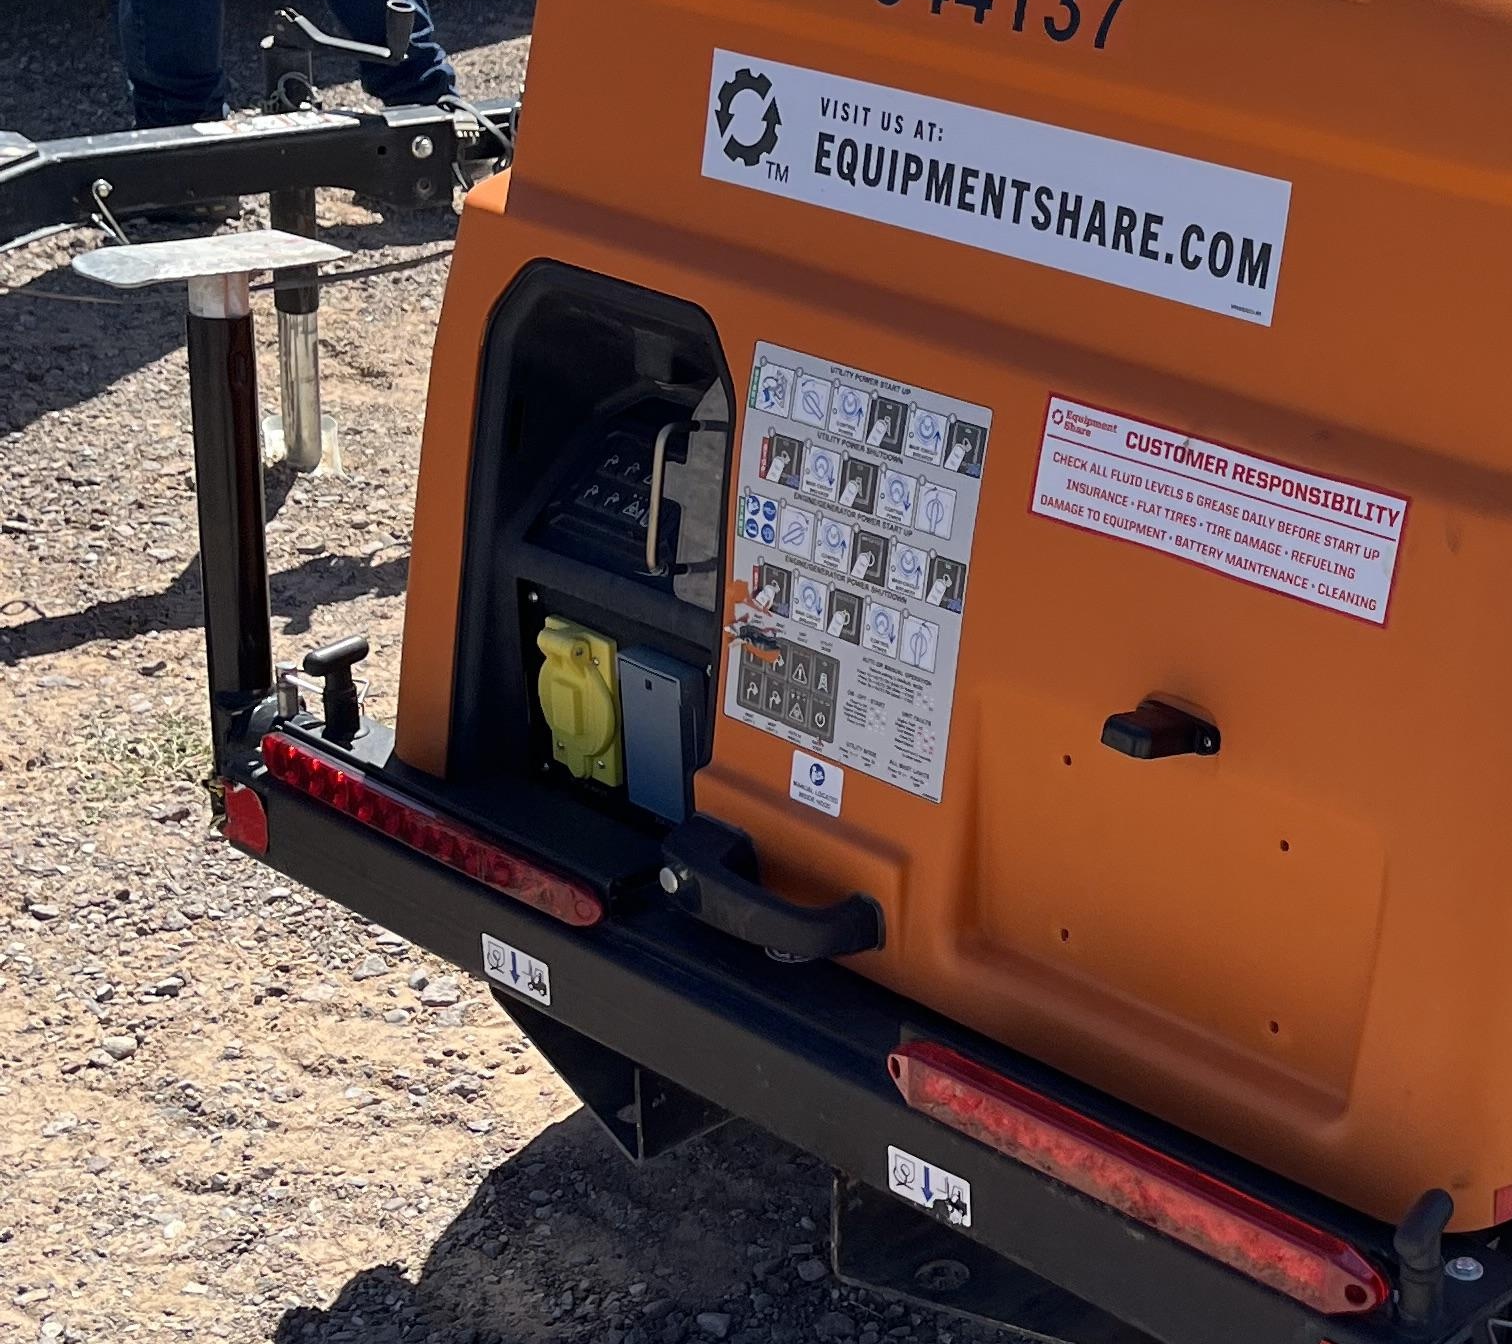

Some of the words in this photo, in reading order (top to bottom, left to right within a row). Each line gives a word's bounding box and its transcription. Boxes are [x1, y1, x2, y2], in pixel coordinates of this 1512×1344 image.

[818, 95, 871, 128] VISIT
[879, 109, 904, 135] US
[913, 118, 944, 145] AT:
[812, 129, 1274, 293] EQUIPMENTSHARE.COM
[1063, 420, 1092, 438] Share
[1064, 409, 1119, 436] Equipment
[1052, 450, 1088, 471] CHECK
[1089, 461, 1108, 478] ALL
[1110, 467, 1143, 488] FLUID
[1144, 478, 1184, 501] LEVELS
[1185, 490, 1194, 504] &
[1195, 494, 1239, 518] GREASE
[1240, 508, 1276, 530] DAILY
[1276, 519, 1322, 544] BEFORE
[1322, 533, 1361, 556] START
[1362, 546, 1380, 563] UP
[1065, 477, 1128, 507] INSURANCE
[1136, 499, 1162, 517] FLAT
[1162, 507, 1197, 528] TIRES
[1204, 520, 1232, 540] TIRE
[1233, 530, 1282, 557] DAMAGE
[1290, 548, 1356, 580] REFUELING
[1124, 429, 1229, 477] CUSTOMER
[1230, 461, 1400, 529] RESPONSIBILITY
[1039, 493, 1084, 517] DAMAGE
[1085, 506, 1101, 522] TO
[1102, 511, 1167, 544] EQUIPMENT
[1173, 533, 1224, 561] BATTERY
[1224, 551, 1309, 590] MAINTENANCE
[1316, 581, 1377, 612] CLEANING
